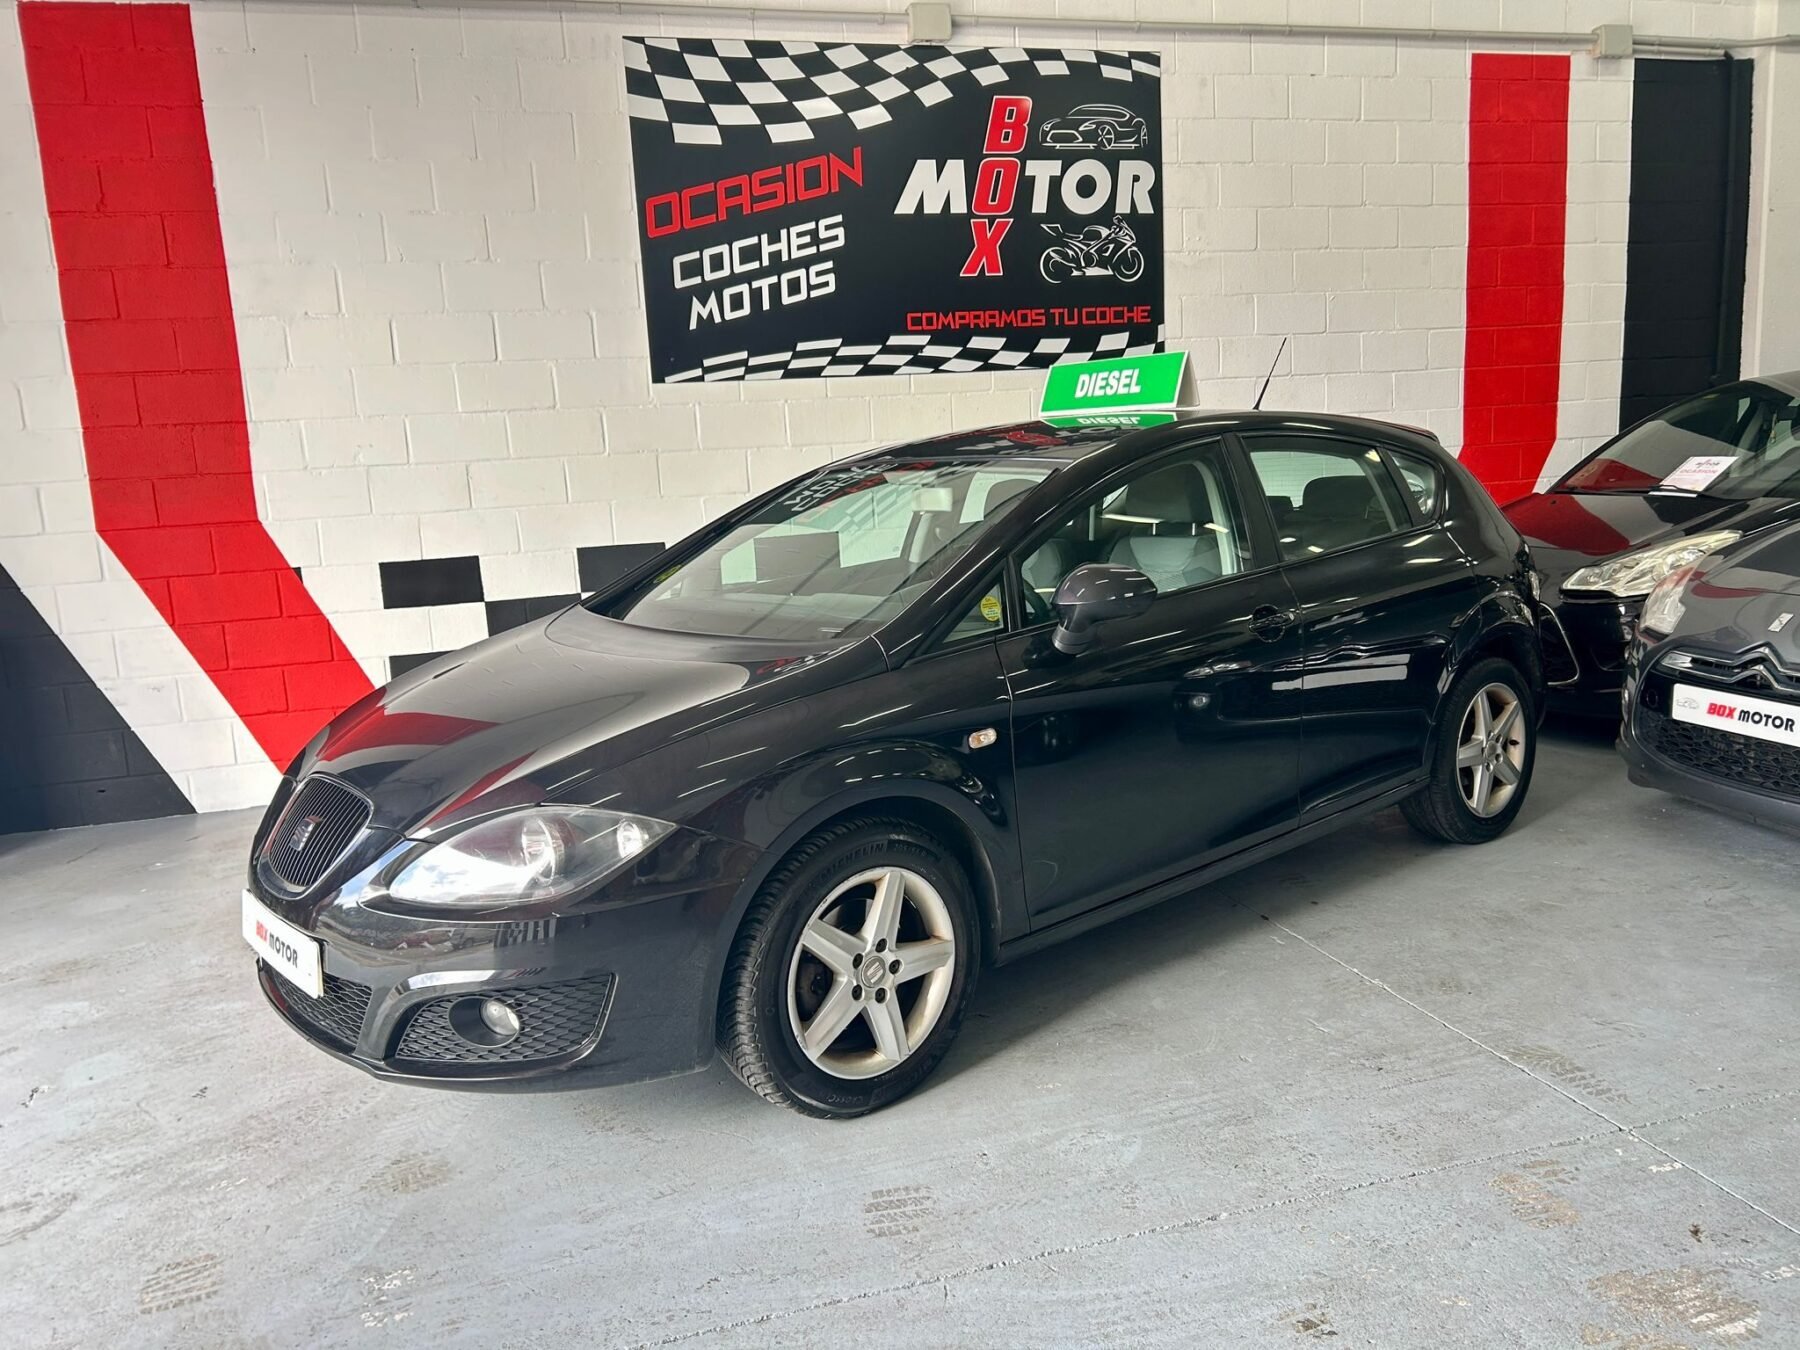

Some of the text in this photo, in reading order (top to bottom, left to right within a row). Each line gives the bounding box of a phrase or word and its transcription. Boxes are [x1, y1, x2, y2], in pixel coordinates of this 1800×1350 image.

[645, 146, 863, 238] OCASION
[894, 158, 1156, 216] MOTOR
[960, 96, 1032, 277] BOX
[672, 214, 845, 289] COCHES
[689, 260, 836, 330] MOTOS
[906, 305, 1152, 331] COMPRAMOS TU COCHE
[1074, 368, 1142, 398] DIESEL
[1707, 702, 1796, 733] BOX MOTOR
[269, 932, 298, 968] MOTOR
